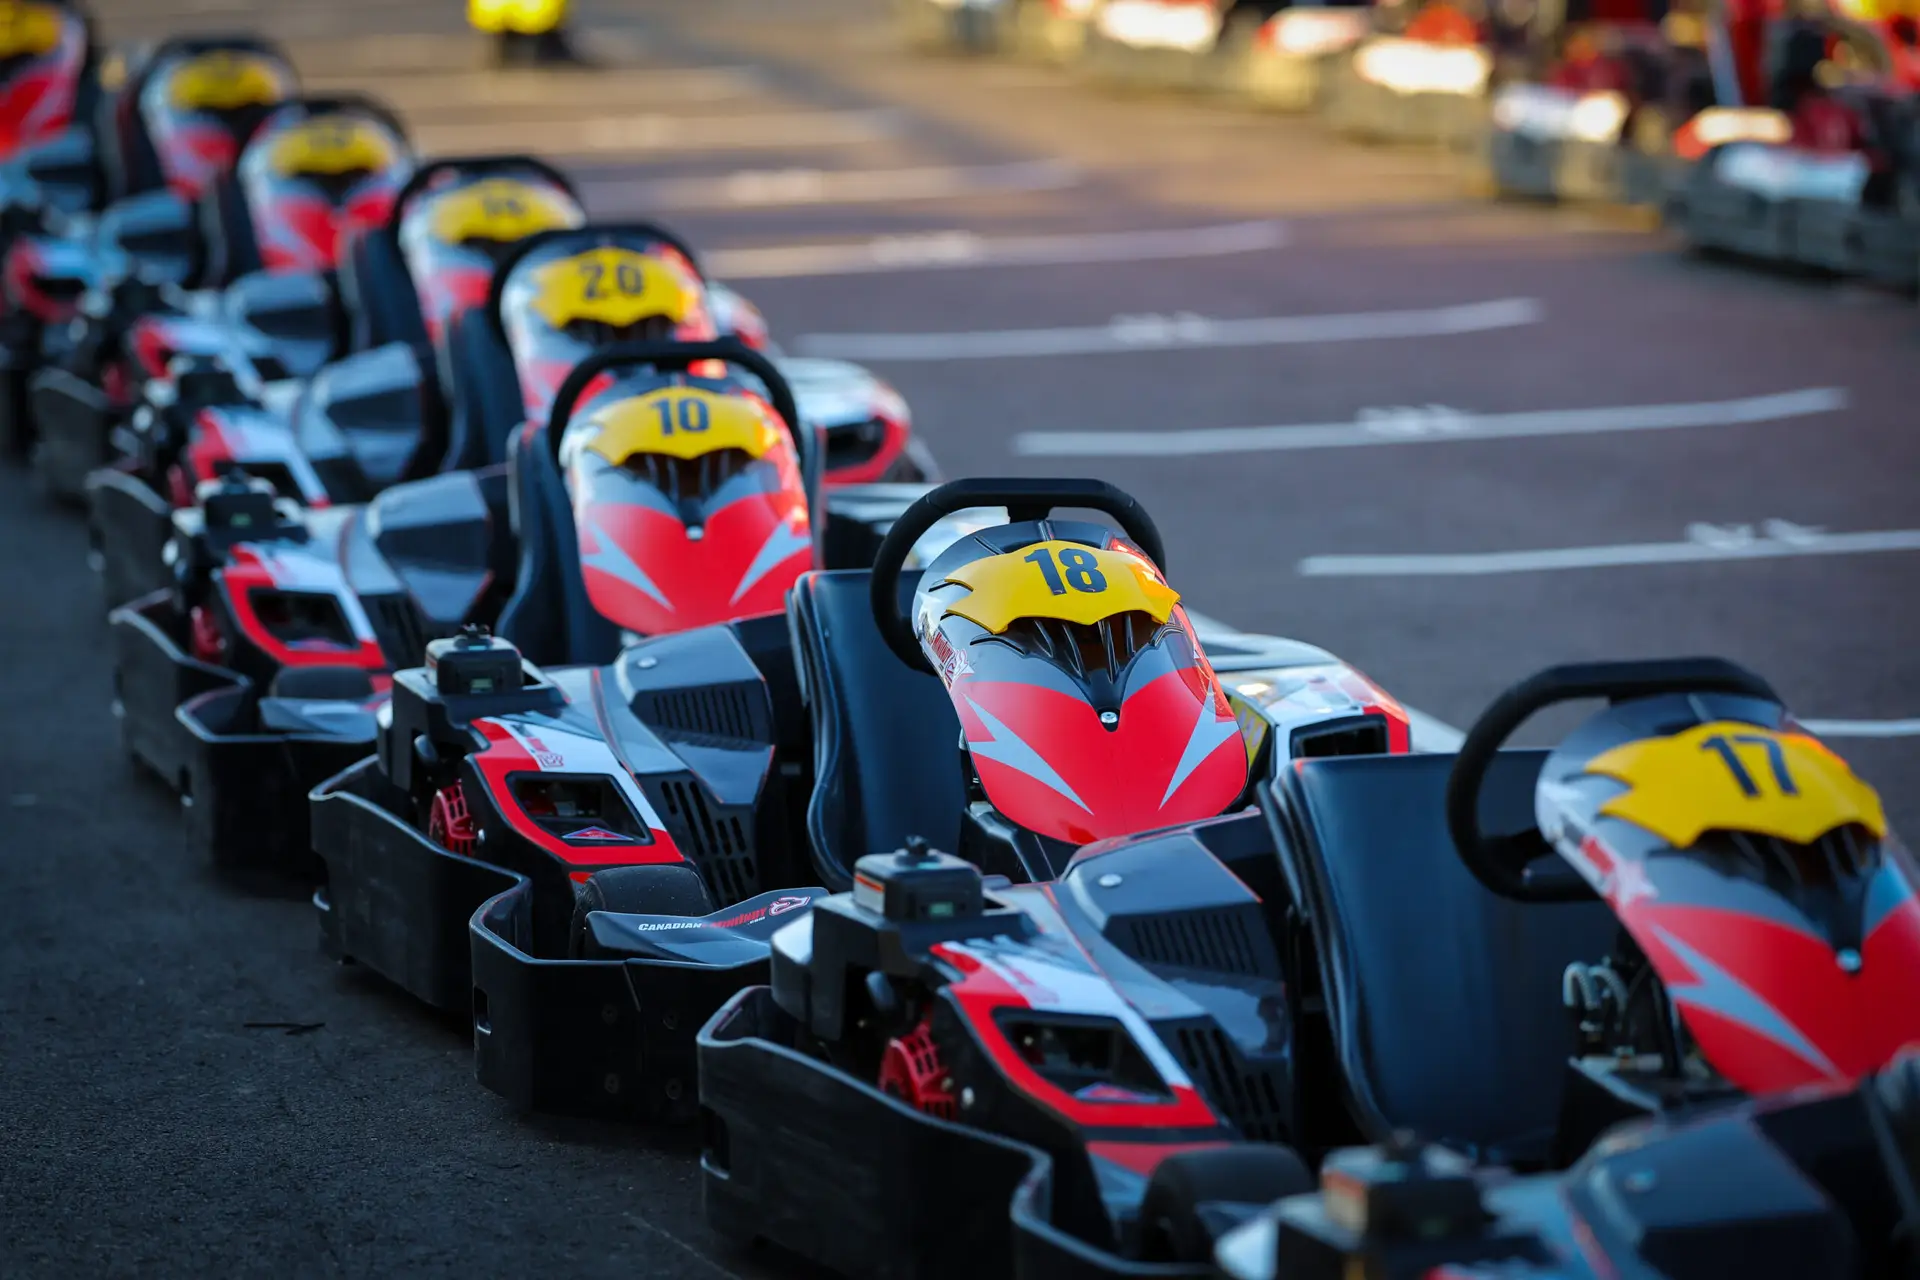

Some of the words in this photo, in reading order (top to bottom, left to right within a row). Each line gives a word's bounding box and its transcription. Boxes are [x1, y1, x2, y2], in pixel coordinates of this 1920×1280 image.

[578, 258, 645, 301] 20
[650, 397, 710, 437] 10
[1024, 548, 1108, 596] 18
[1701, 734, 1800, 797] 17
[638, 921, 702, 932] CANADIAN
